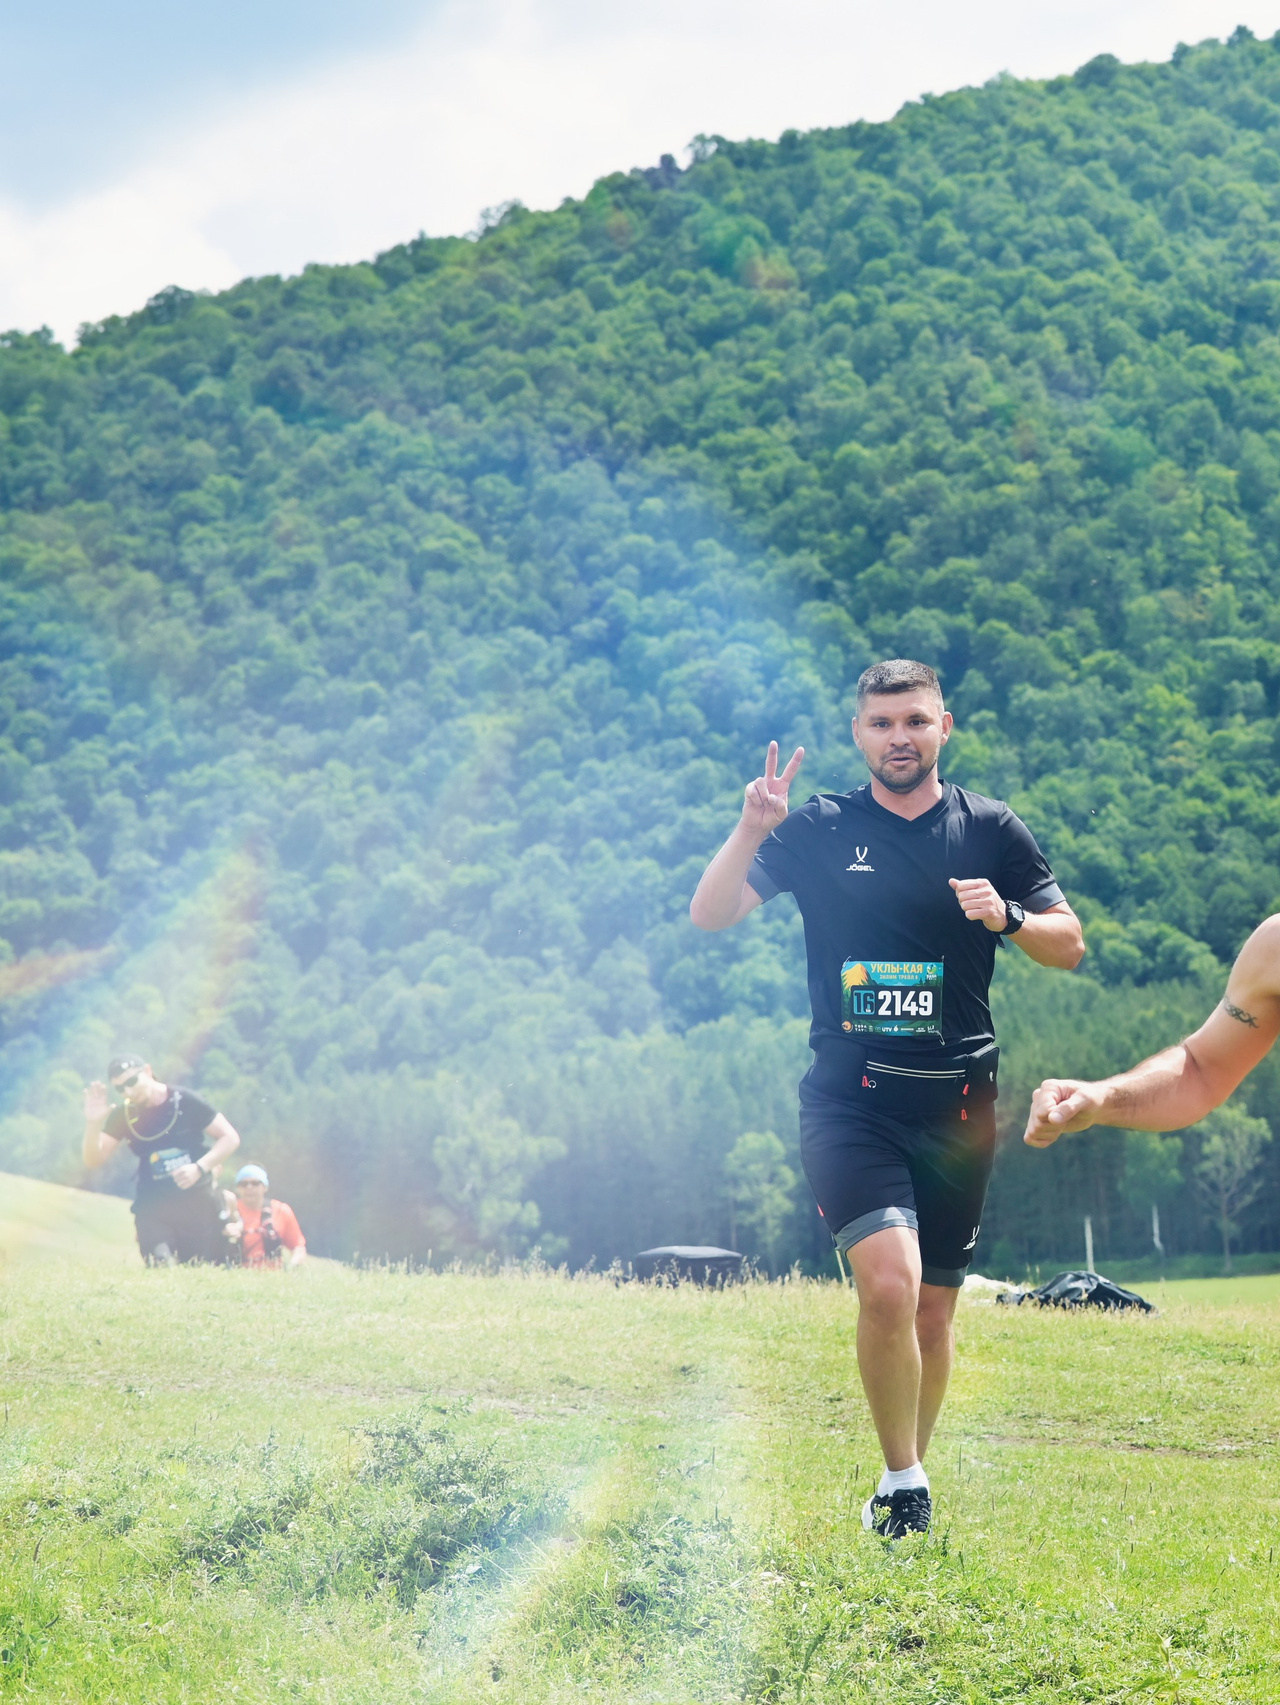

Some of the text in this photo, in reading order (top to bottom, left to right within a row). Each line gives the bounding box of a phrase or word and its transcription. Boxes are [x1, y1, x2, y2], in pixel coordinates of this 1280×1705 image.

[846, 863, 875, 872] JÖGEL
[871, 963, 923, 974] УКЛЫ-КАЯ
[855, 990, 933, 1016] 16 2149
